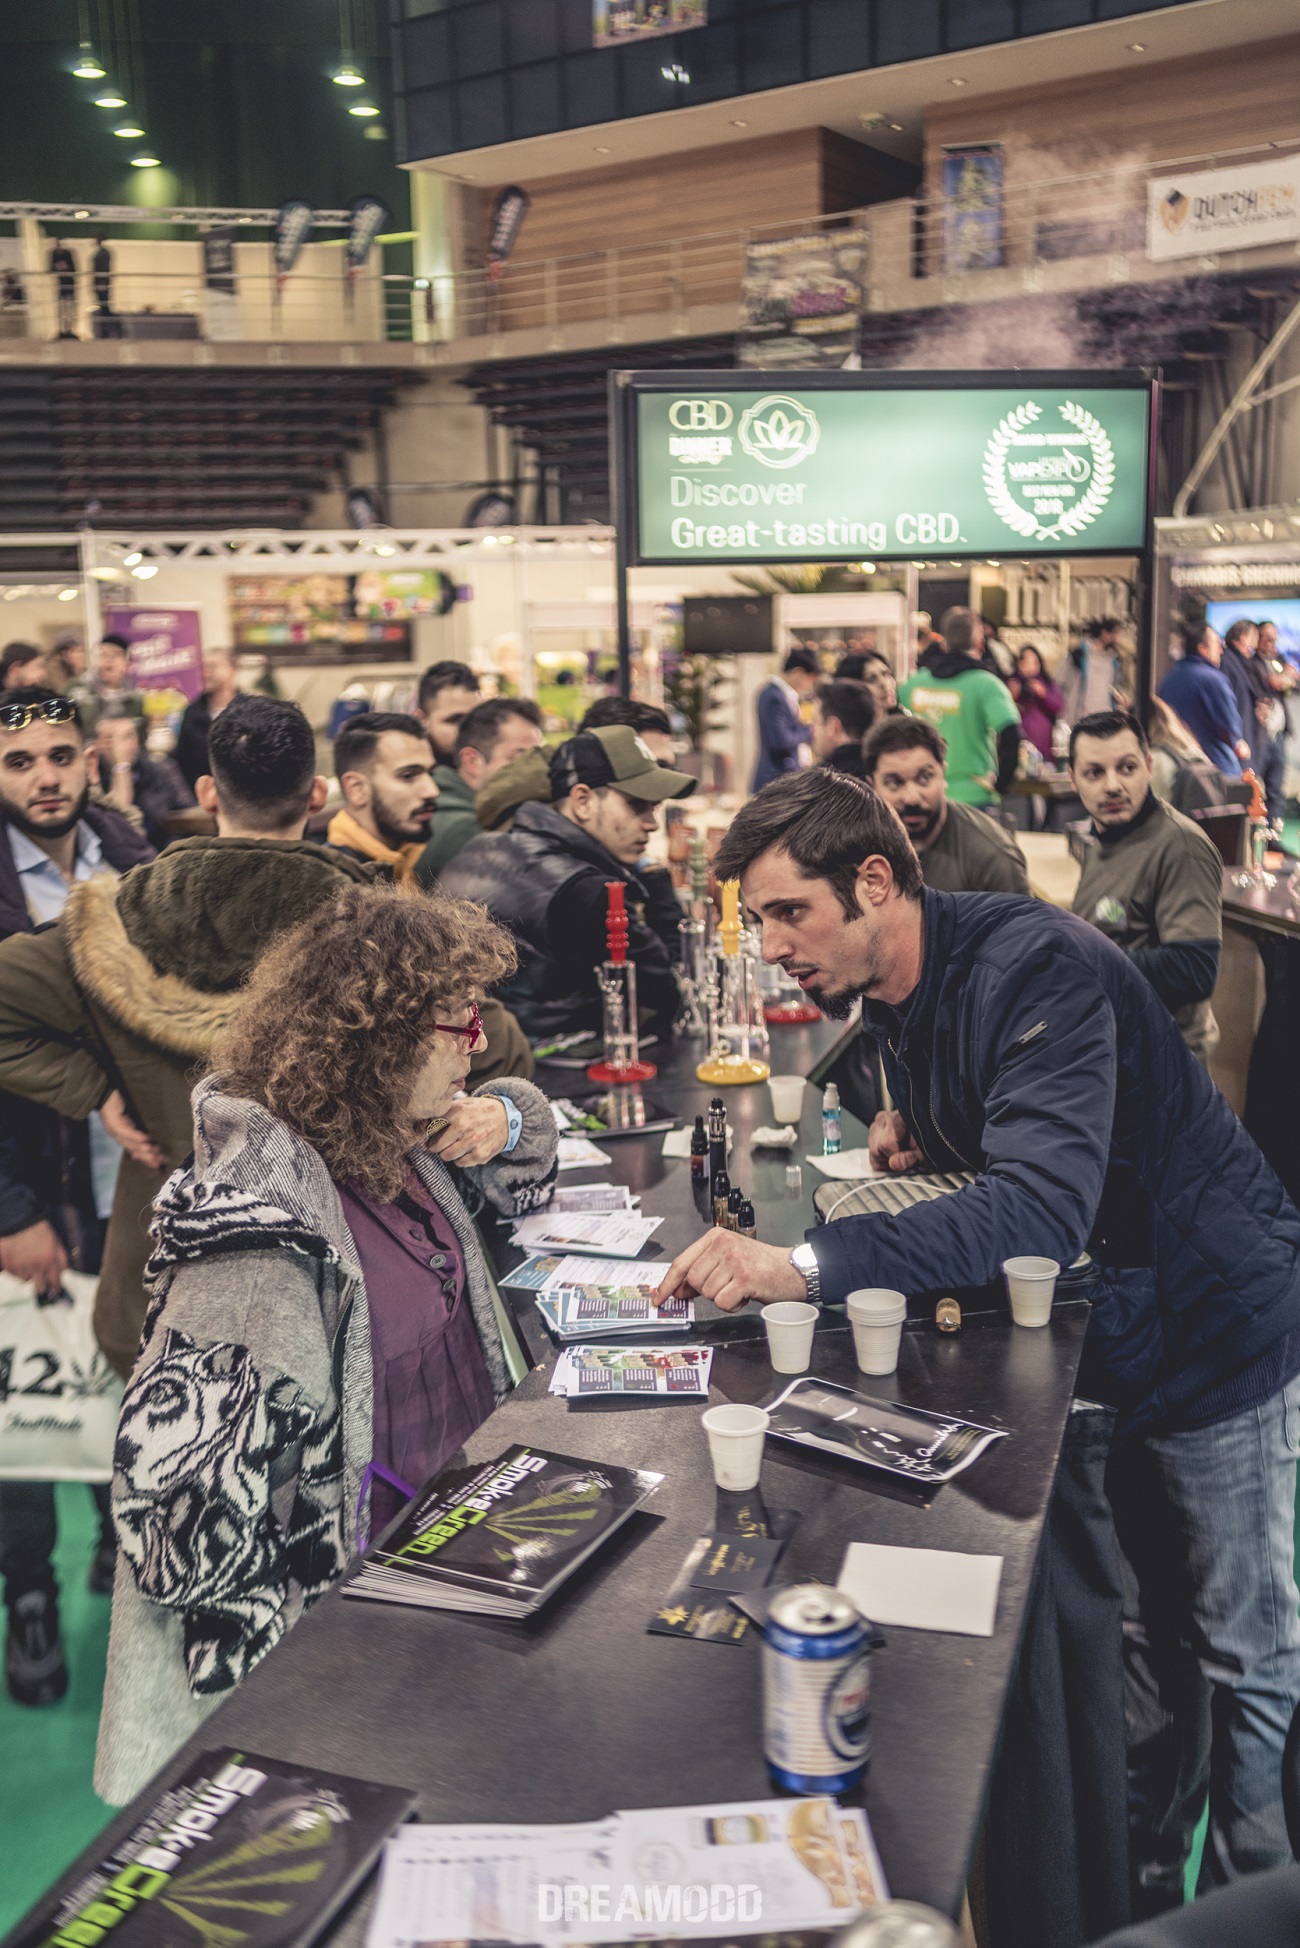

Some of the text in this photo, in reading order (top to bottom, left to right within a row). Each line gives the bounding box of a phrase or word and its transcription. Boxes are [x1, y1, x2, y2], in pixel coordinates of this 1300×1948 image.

[668, 400, 734, 431] CBD
[670, 476, 807, 507] Discover
[670, 512, 968, 551] Great-tasting CBD.
